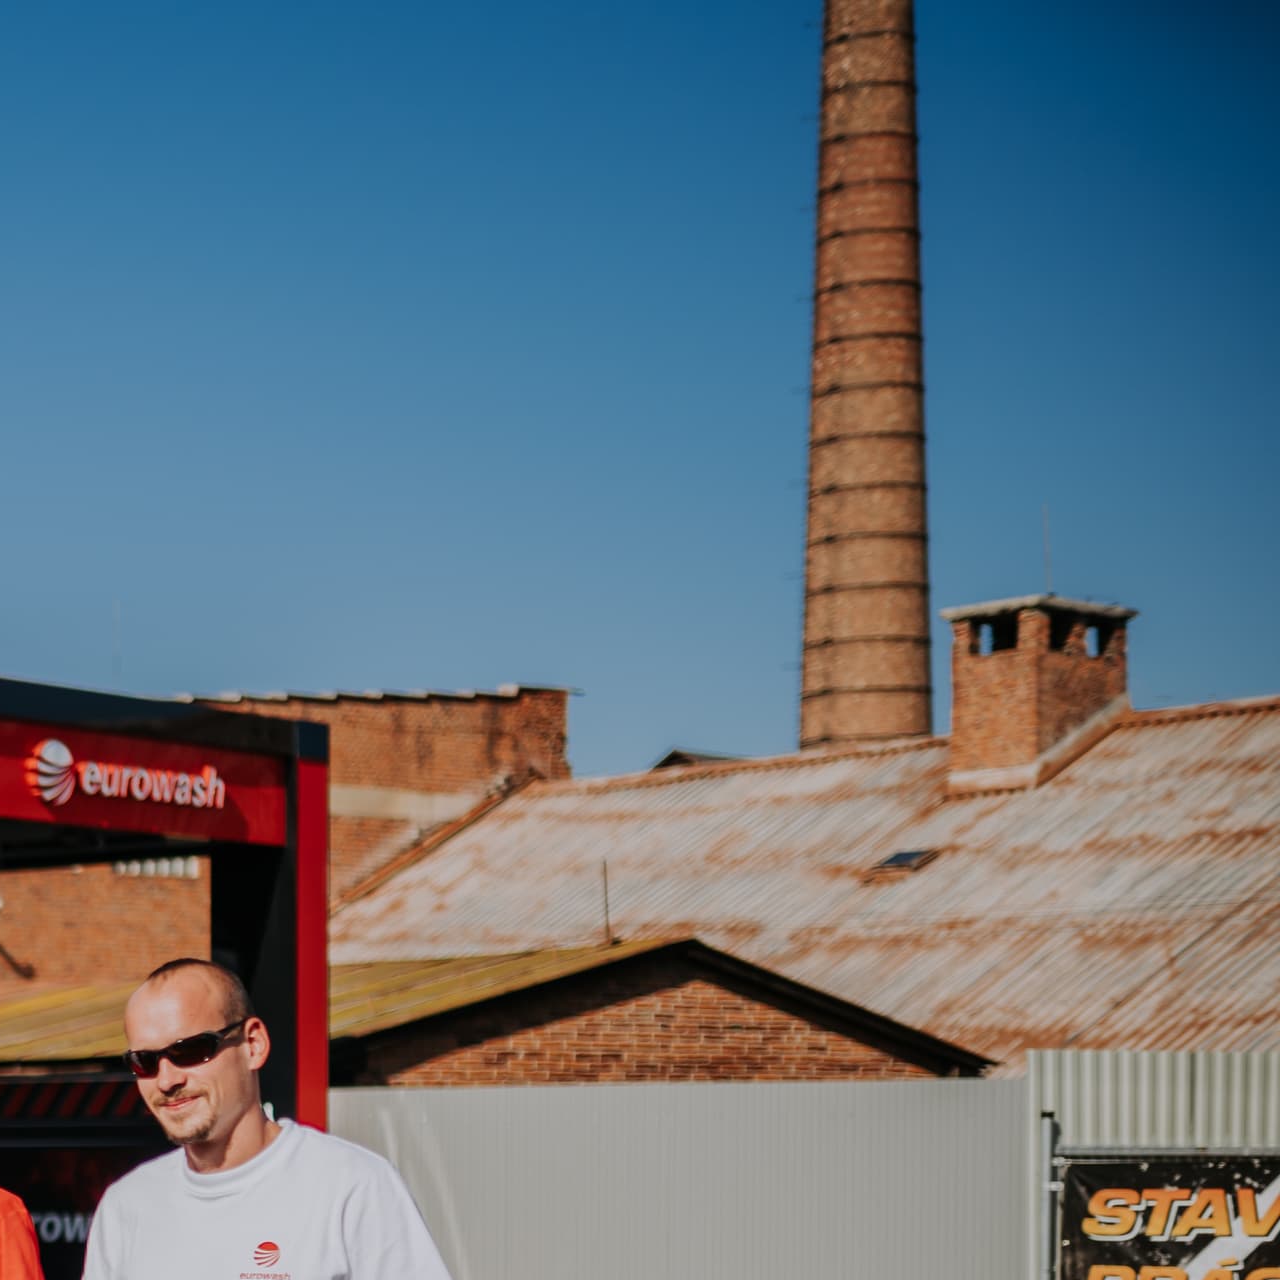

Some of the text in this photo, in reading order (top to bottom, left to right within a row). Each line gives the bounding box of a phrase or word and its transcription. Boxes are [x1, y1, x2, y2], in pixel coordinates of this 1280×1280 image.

[79, 760, 226, 810] eurowash
[1081, 1188, 1280, 1242] STAV
[240, 1272, 291, 1280] eurowash
